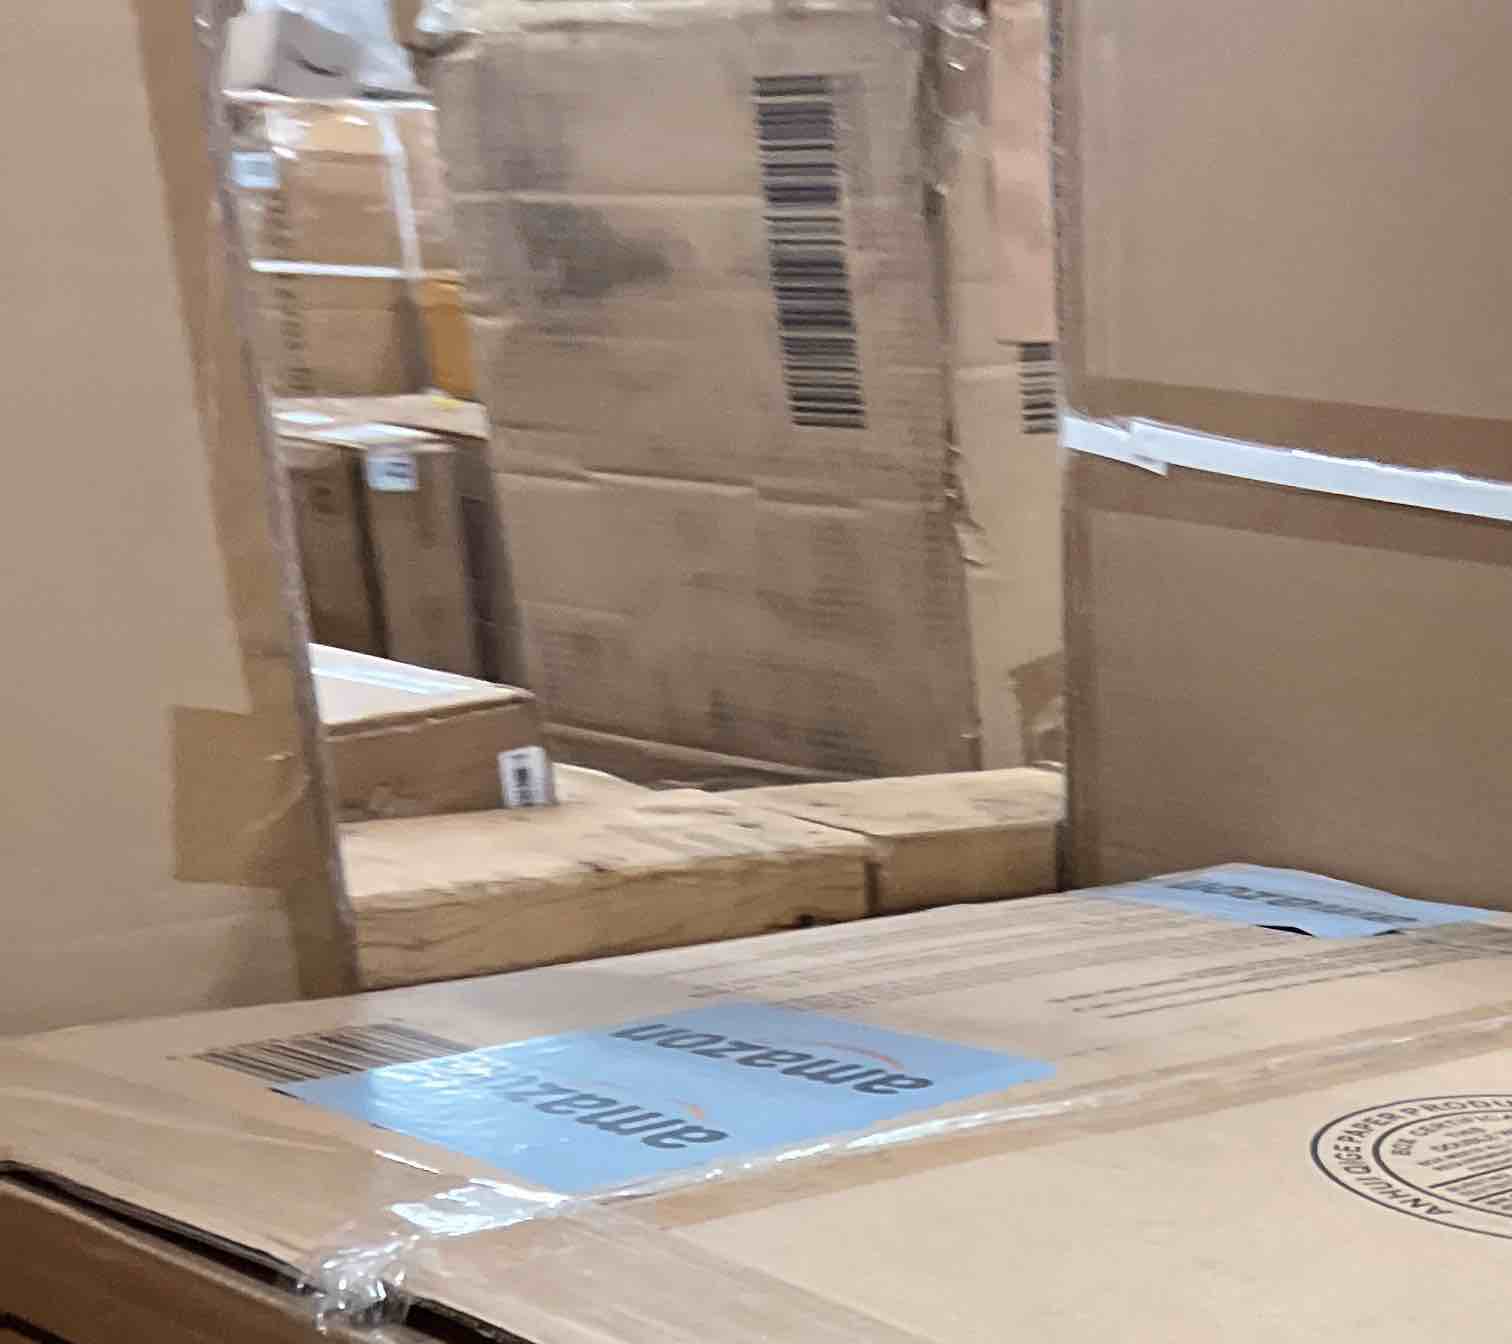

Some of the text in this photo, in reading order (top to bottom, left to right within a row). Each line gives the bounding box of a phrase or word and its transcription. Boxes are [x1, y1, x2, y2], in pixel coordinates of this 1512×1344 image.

[610, 1023, 934, 1095] amazon
[485, 1072, 728, 1149] amazo
[1334, 1112, 1399, 1145] PAPER
